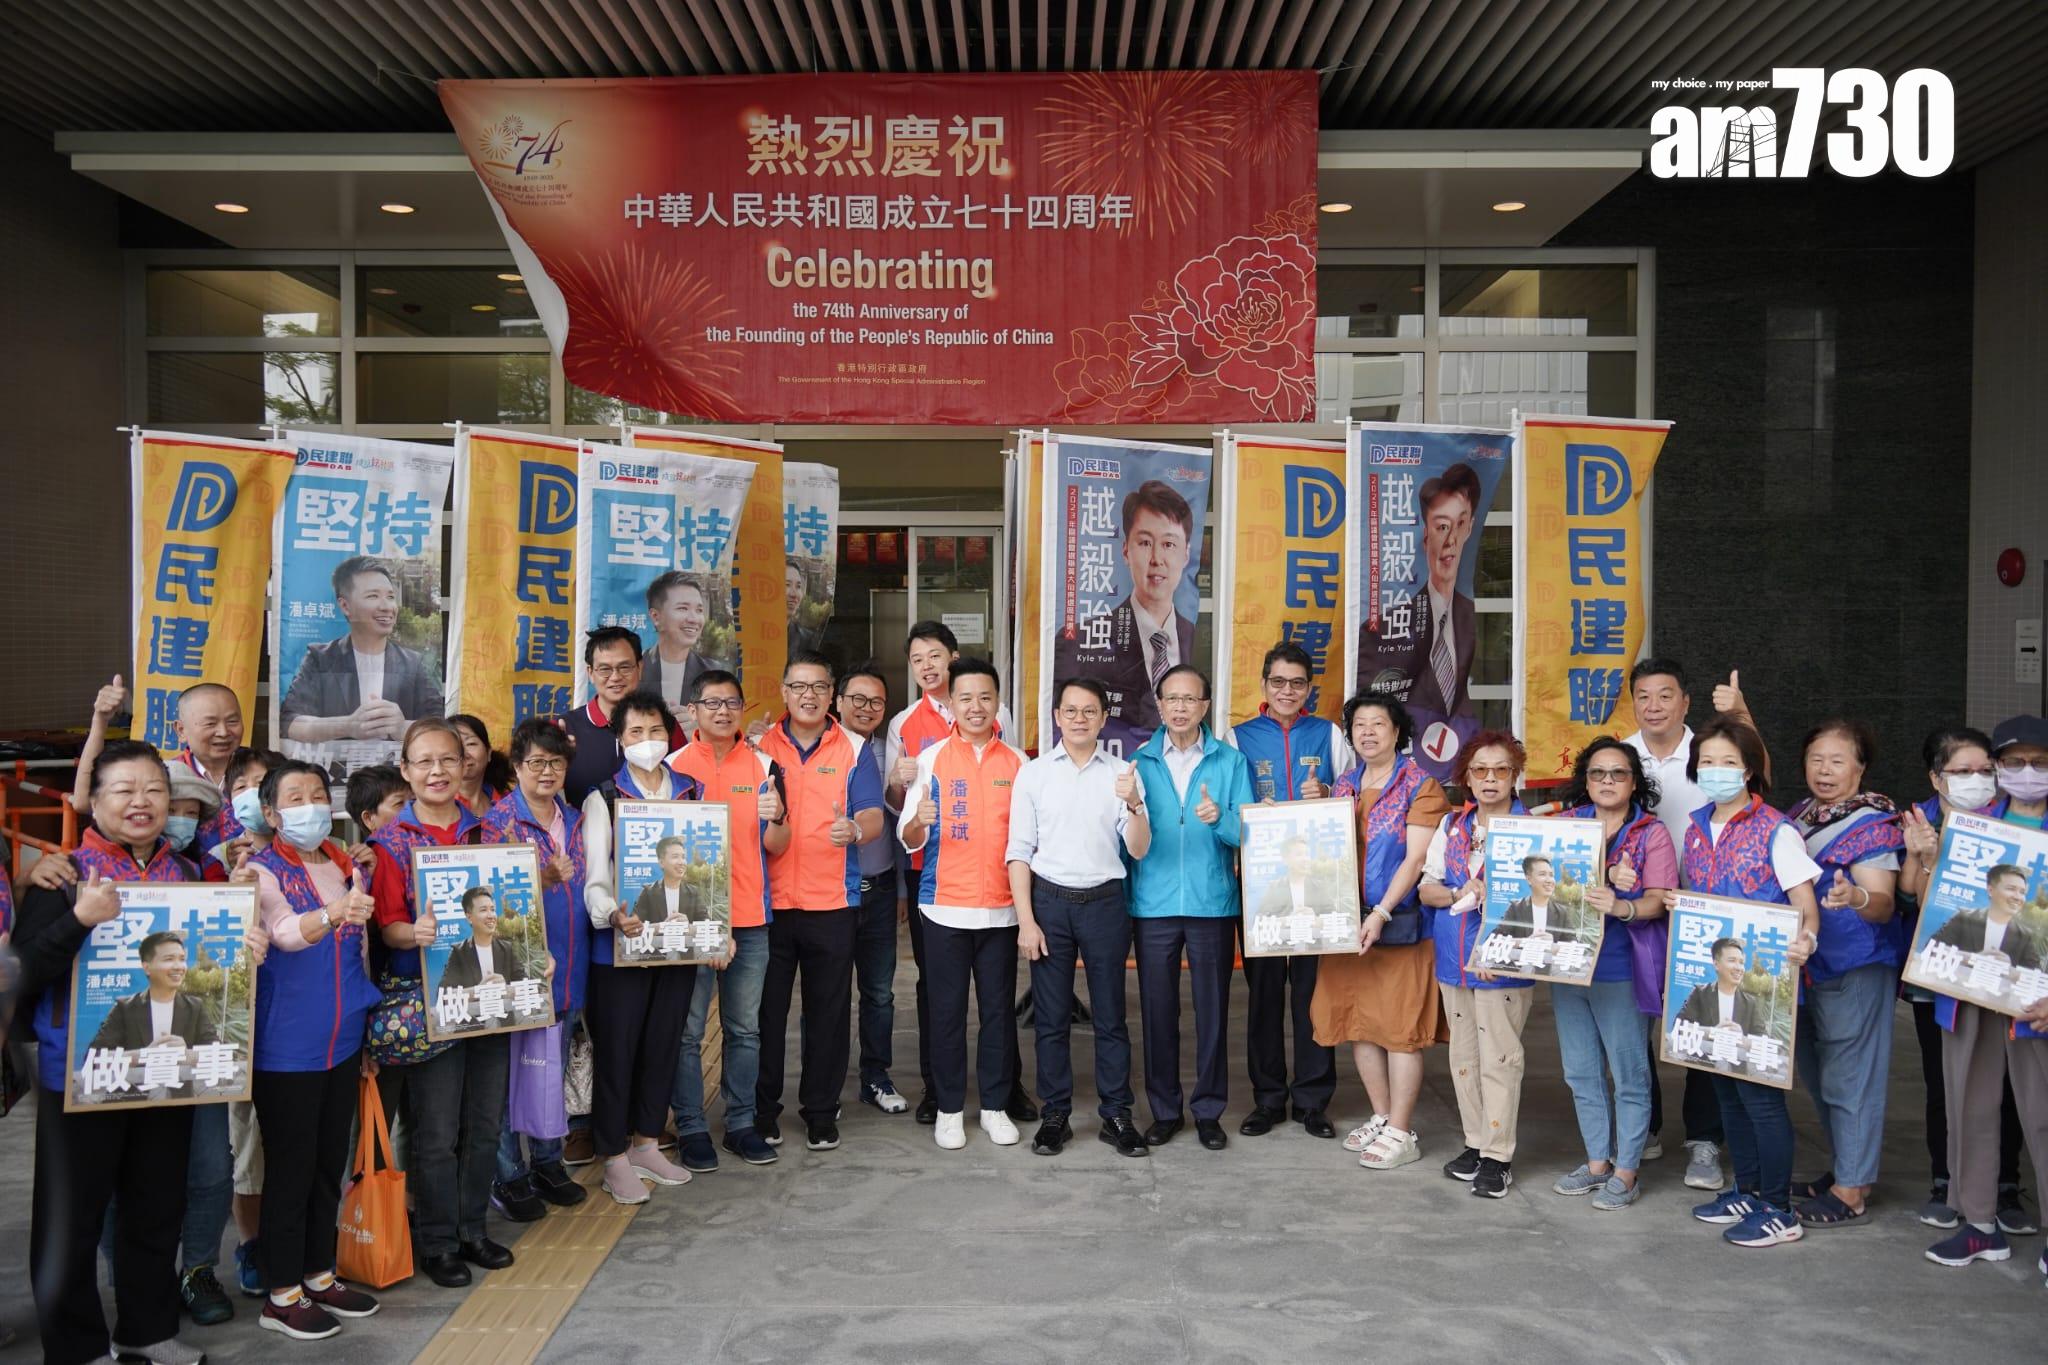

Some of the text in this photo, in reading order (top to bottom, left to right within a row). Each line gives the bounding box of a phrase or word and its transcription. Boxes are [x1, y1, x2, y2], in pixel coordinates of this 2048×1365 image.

[746, 114, 1009, 178] 熱烈慶祝
[623, 192, 1135, 231] 中華人民共和國成立七十四周年
[767, 246, 995, 299] Celebrating
[793, 303, 969, 323] the 74th Anniversary of
[706, 327, 1054, 347] the Founding of the People's Republic of China
[778, 376, 791, 384] The
[792, 376, 831, 385] Government
[853, 377, 870, 386] Hong
[872, 377, 890, 387] Kong
[891, 377, 915, 387] Special
[916, 377, 961, 385] Administrative
[962, 378, 986, 387] Region
[837, 363, 928, 374] 香港特別行政區政府
[310, 449, 353, 464] 民建聯
[619, 463, 659, 479] 民建聯
[1085, 459, 1121, 473] 民建聯
[1386, 446, 1422, 459] 民建聯
[293, 487, 432, 556] 堅持
[607, 502, 733, 570] 堅持
[1079, 485, 1117, 650] 越毅強
[1381, 473, 1418, 641] 越毅強
[289, 601, 336, 619] 潘卓斌
[1568, 528, 1627, 726] 民建聯
[1077, 654, 1095, 664] Kyle
[1378, 645, 1395, 654] Kyle
[950, 778, 969, 842] 潘卓斌
[624, 820, 722, 865] 堅持
[1250, 817, 1346, 864] 堅持
[1491, 835, 1593, 884] 堅持
[624, 867, 652, 878] 潘卓斌
[1491, 881, 1520, 893] 潘卓斌
[425, 865, 533, 921] 堅持
[1937, 882, 1976, 902] 潘卓斌
[87, 909, 245, 970] 堅持
[624, 919, 723, 955] 做實事
[1253, 911, 1351, 947] 做實事
[1676, 914, 1790, 976] 堅持
[1481, 933, 1591, 971] 做實事
[1675, 962, 1705, 977] 潘卓斌
[86, 974, 132, 989] 潘卓斌
[436, 978, 545, 1027] 做實事
[1671, 1018, 1784, 1072] 做實事
[81, 1042, 241, 1096] 做實事
